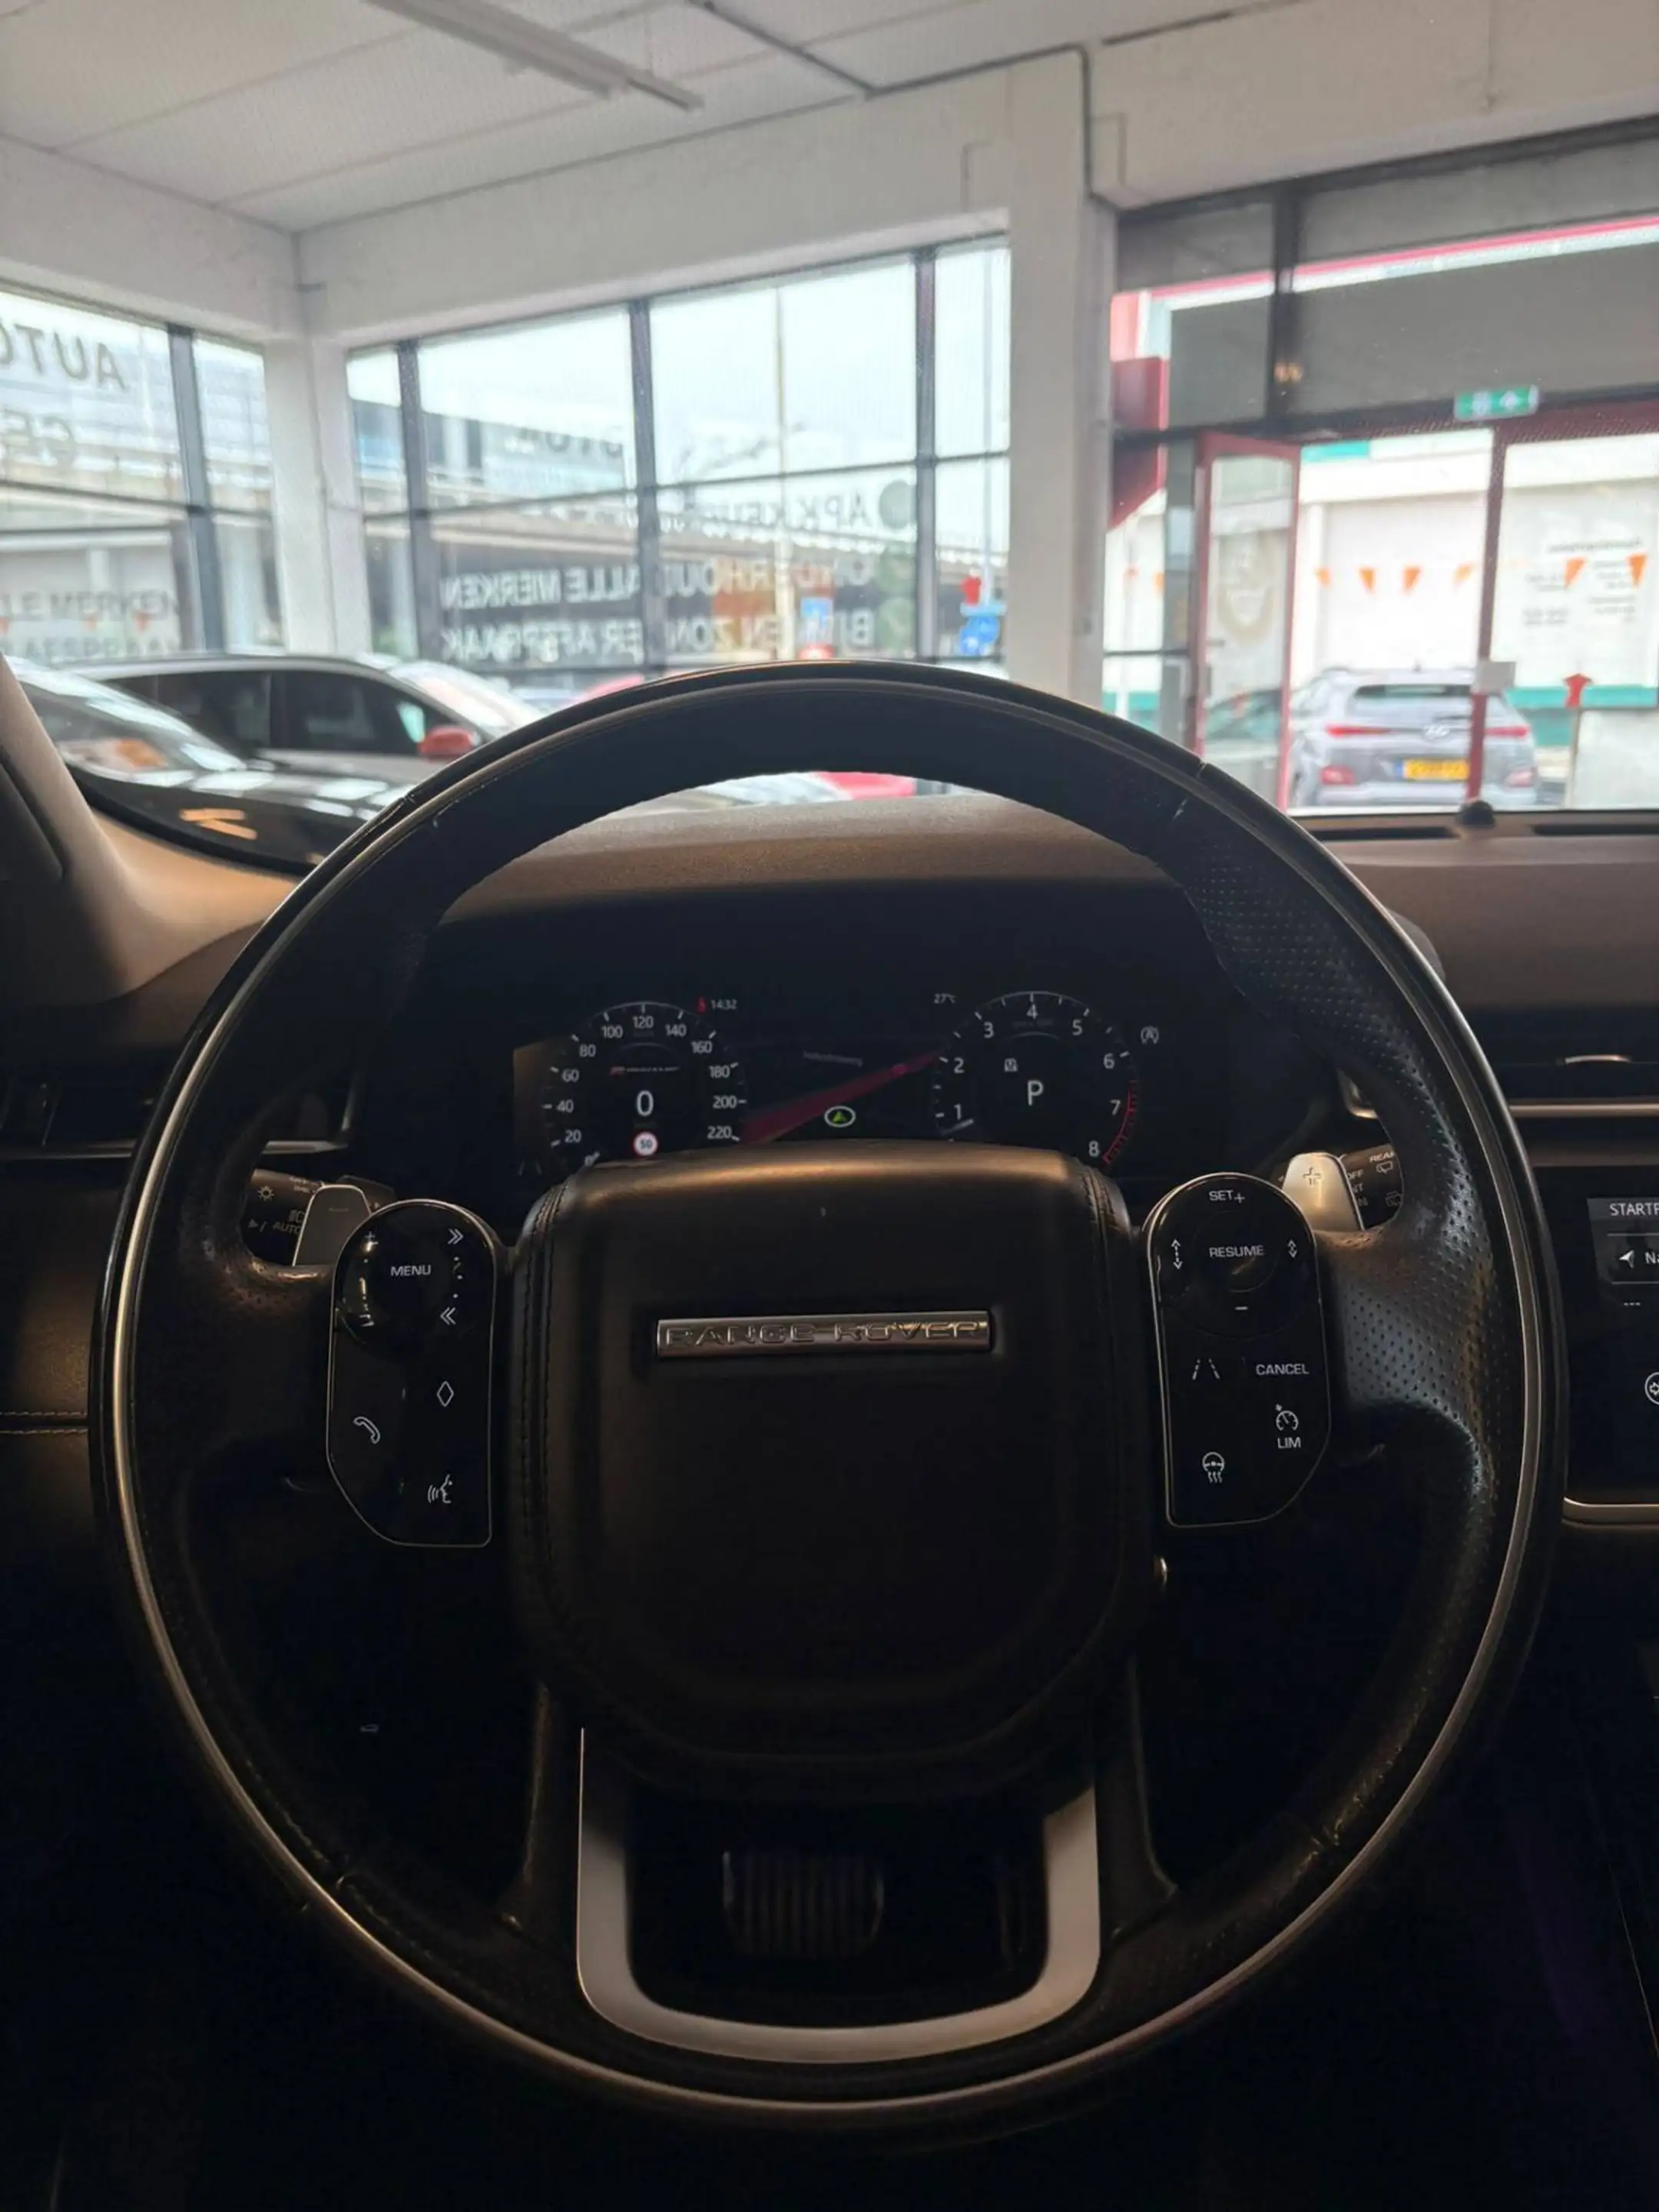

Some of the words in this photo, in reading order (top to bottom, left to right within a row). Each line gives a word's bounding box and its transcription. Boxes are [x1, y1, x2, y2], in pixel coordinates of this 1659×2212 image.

[1027, 1005, 1038, 1019] 4
[633, 1015, 654, 1028] 120
[1073, 1019, 1082, 1035] 5
[601, 1025, 623, 1038] 100
[665, 1024, 687, 1037] 140
[984, 1022, 995, 1038] 3
[579, 1045, 596, 1057] 80
[691, 1041, 713, 1054] 160
[954, 1058, 964, 1073] 2
[1104, 1053, 1114, 1068] 6
[561, 1069, 579, 1082] 60
[709, 1065, 730, 1078] 180
[1028, 1081, 1044, 1105] P
[557, 1099, 574, 1113] 40
[636, 1091, 654, 1116] 0
[713, 1095, 737, 1108] 200
[1111, 1100, 1121, 1114] 7
[954, 1104, 962, 1119] 1
[565, 1130, 581, 1143] 20
[707, 1126, 732, 1139] 220
[640, 1139, 652, 1149] 50
[1089, 1141, 1099, 1157] 8
[1209, 1244, 1263, 1258] RESUME
[390, 1264, 432, 1277] MENU
[665, 1323, 816, 1347] RANGE
[833, 1319, 981, 1343] ROVER
[1256, 1363, 1310, 1376] CANCEL
[1277, 1437, 1301, 1449] LIM
